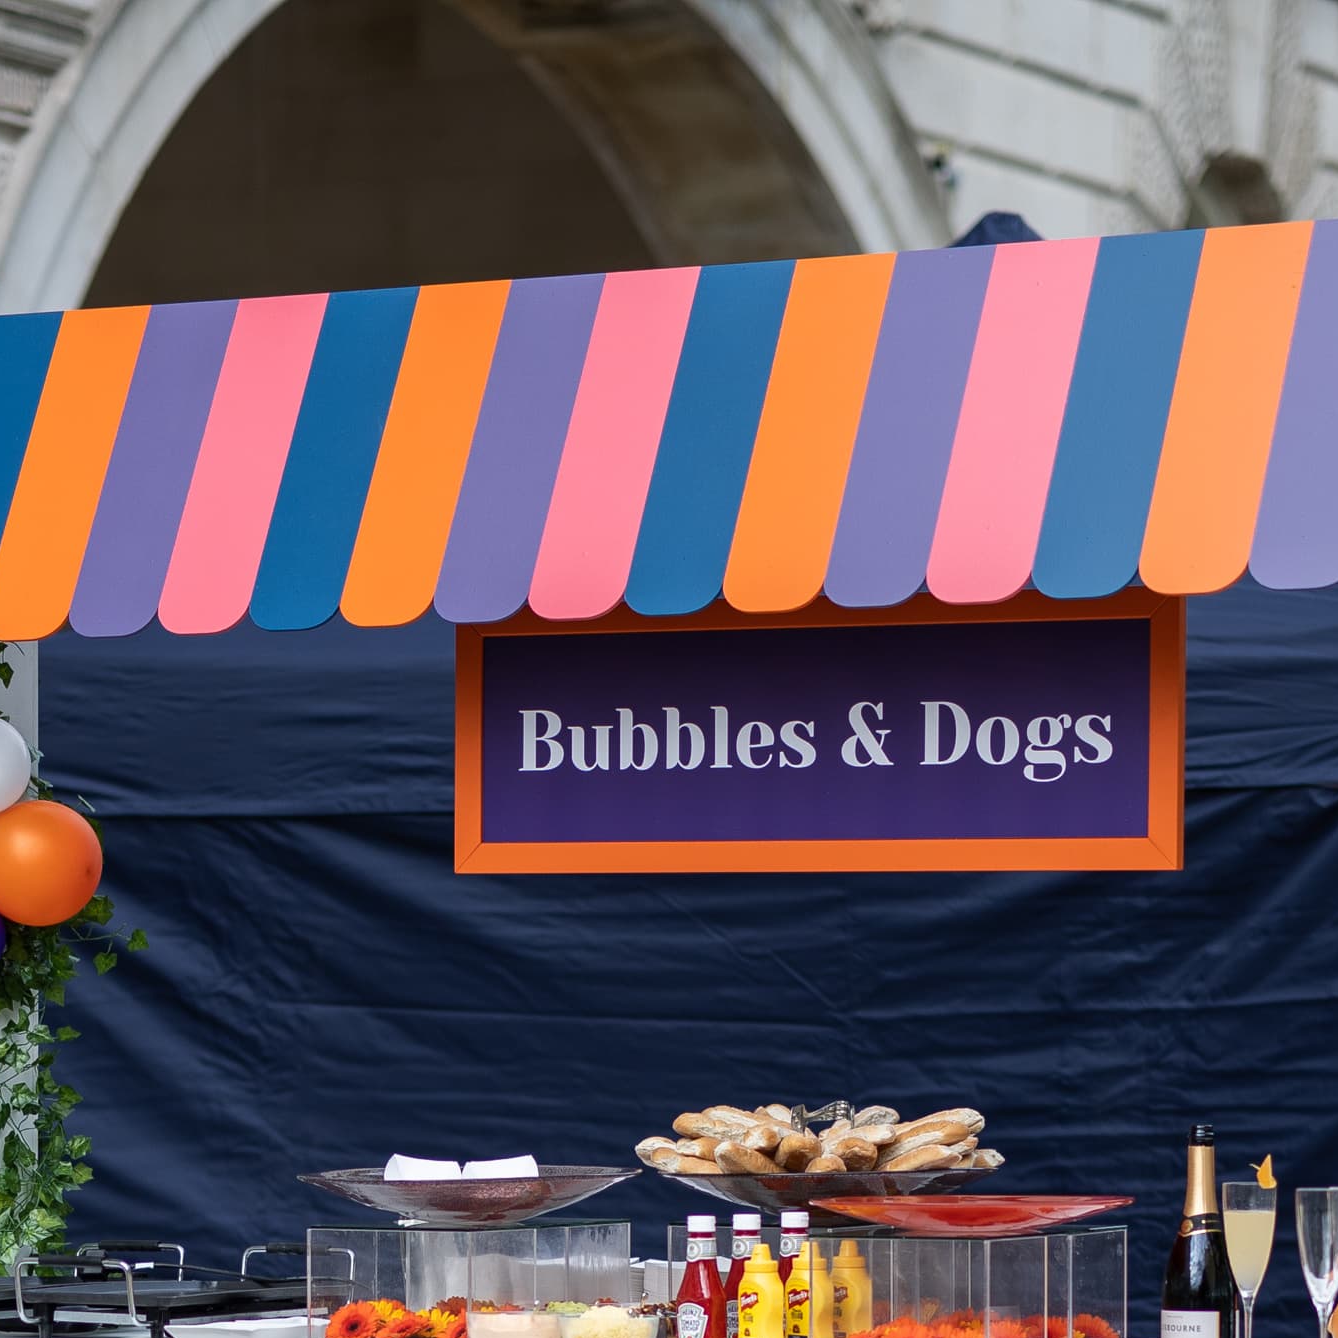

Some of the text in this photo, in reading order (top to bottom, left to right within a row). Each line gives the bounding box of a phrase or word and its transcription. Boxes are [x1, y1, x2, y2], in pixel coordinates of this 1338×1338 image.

[518, 700, 1114, 783] Bubbles & Dogs
